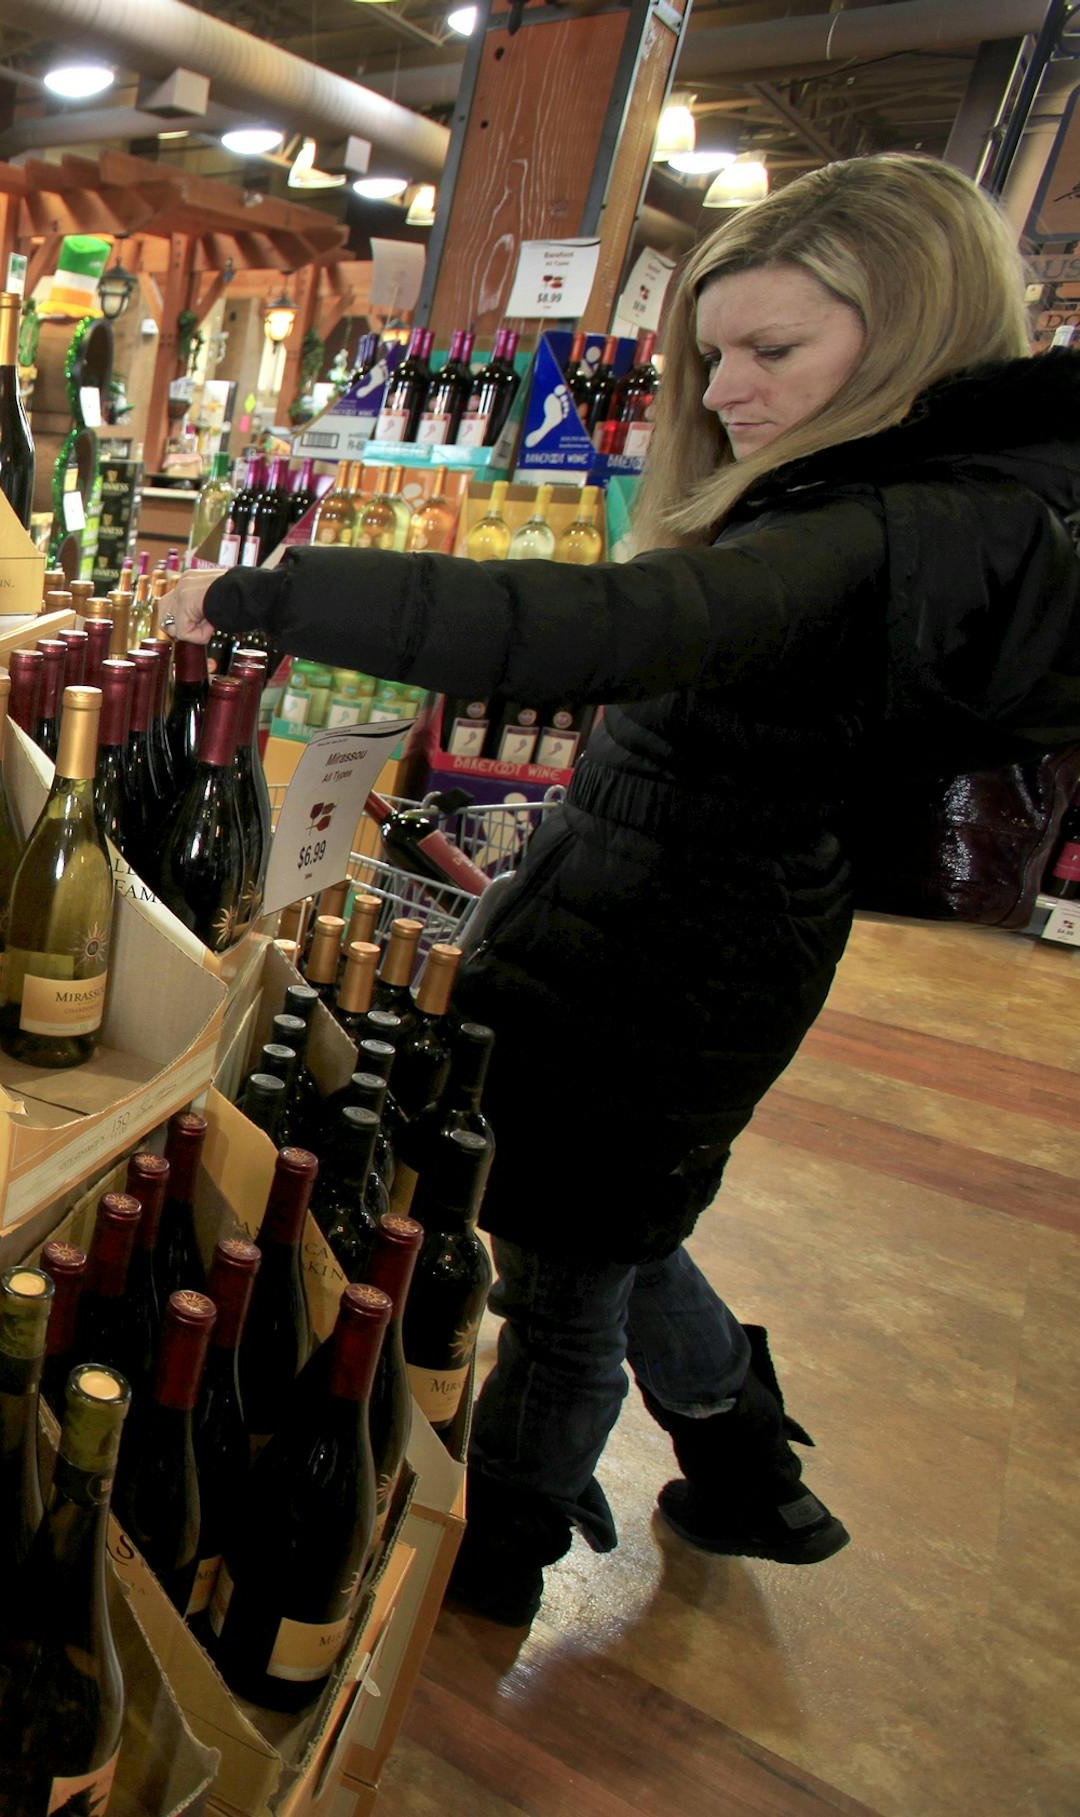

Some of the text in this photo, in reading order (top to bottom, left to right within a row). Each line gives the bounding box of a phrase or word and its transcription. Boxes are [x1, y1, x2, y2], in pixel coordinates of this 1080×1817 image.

[325, 749, 368, 767] Mirassou
[528, 766, 561, 781] WINE
[297, 839, 327, 869] $6.99
